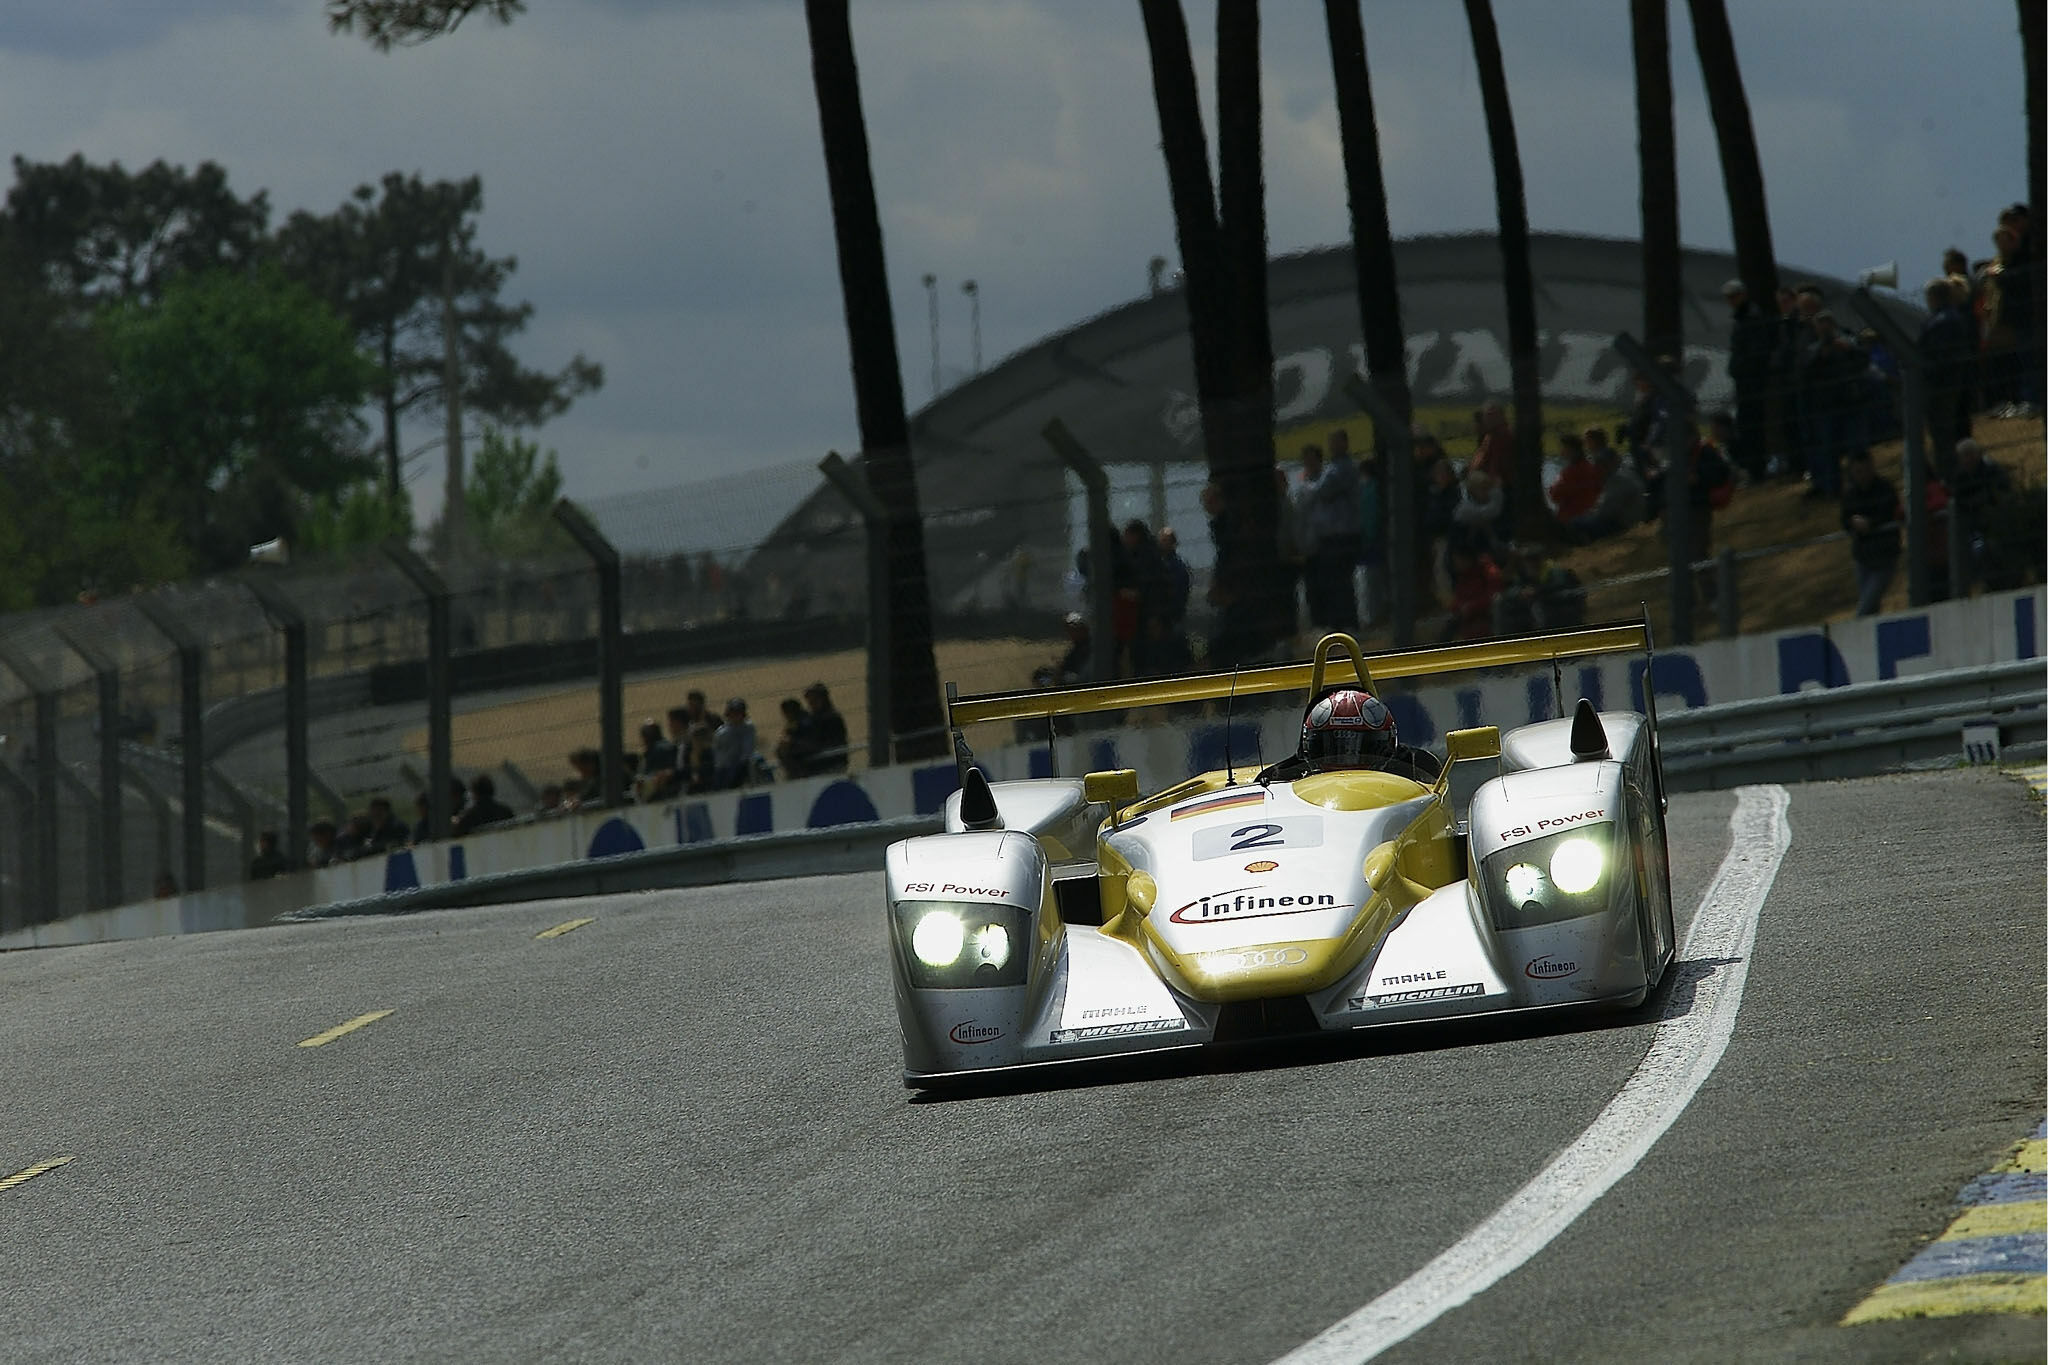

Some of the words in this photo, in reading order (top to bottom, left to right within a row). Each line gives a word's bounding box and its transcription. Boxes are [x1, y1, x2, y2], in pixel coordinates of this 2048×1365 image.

[1500, 825, 1532, 842] FSI
[1537, 809, 1605, 830] Power
[1230, 824, 1285, 851] 2
[904, 882, 935, 893] FSI
[941, 883, 1011, 899] Power
[1381, 970, 1447, 986] MAHLE
[1379, 984, 1480, 1004] MICHELIN
[1082, 1005, 1148, 1019] MAHLE
[1080, 1019, 1181, 1037] MICHELIN
